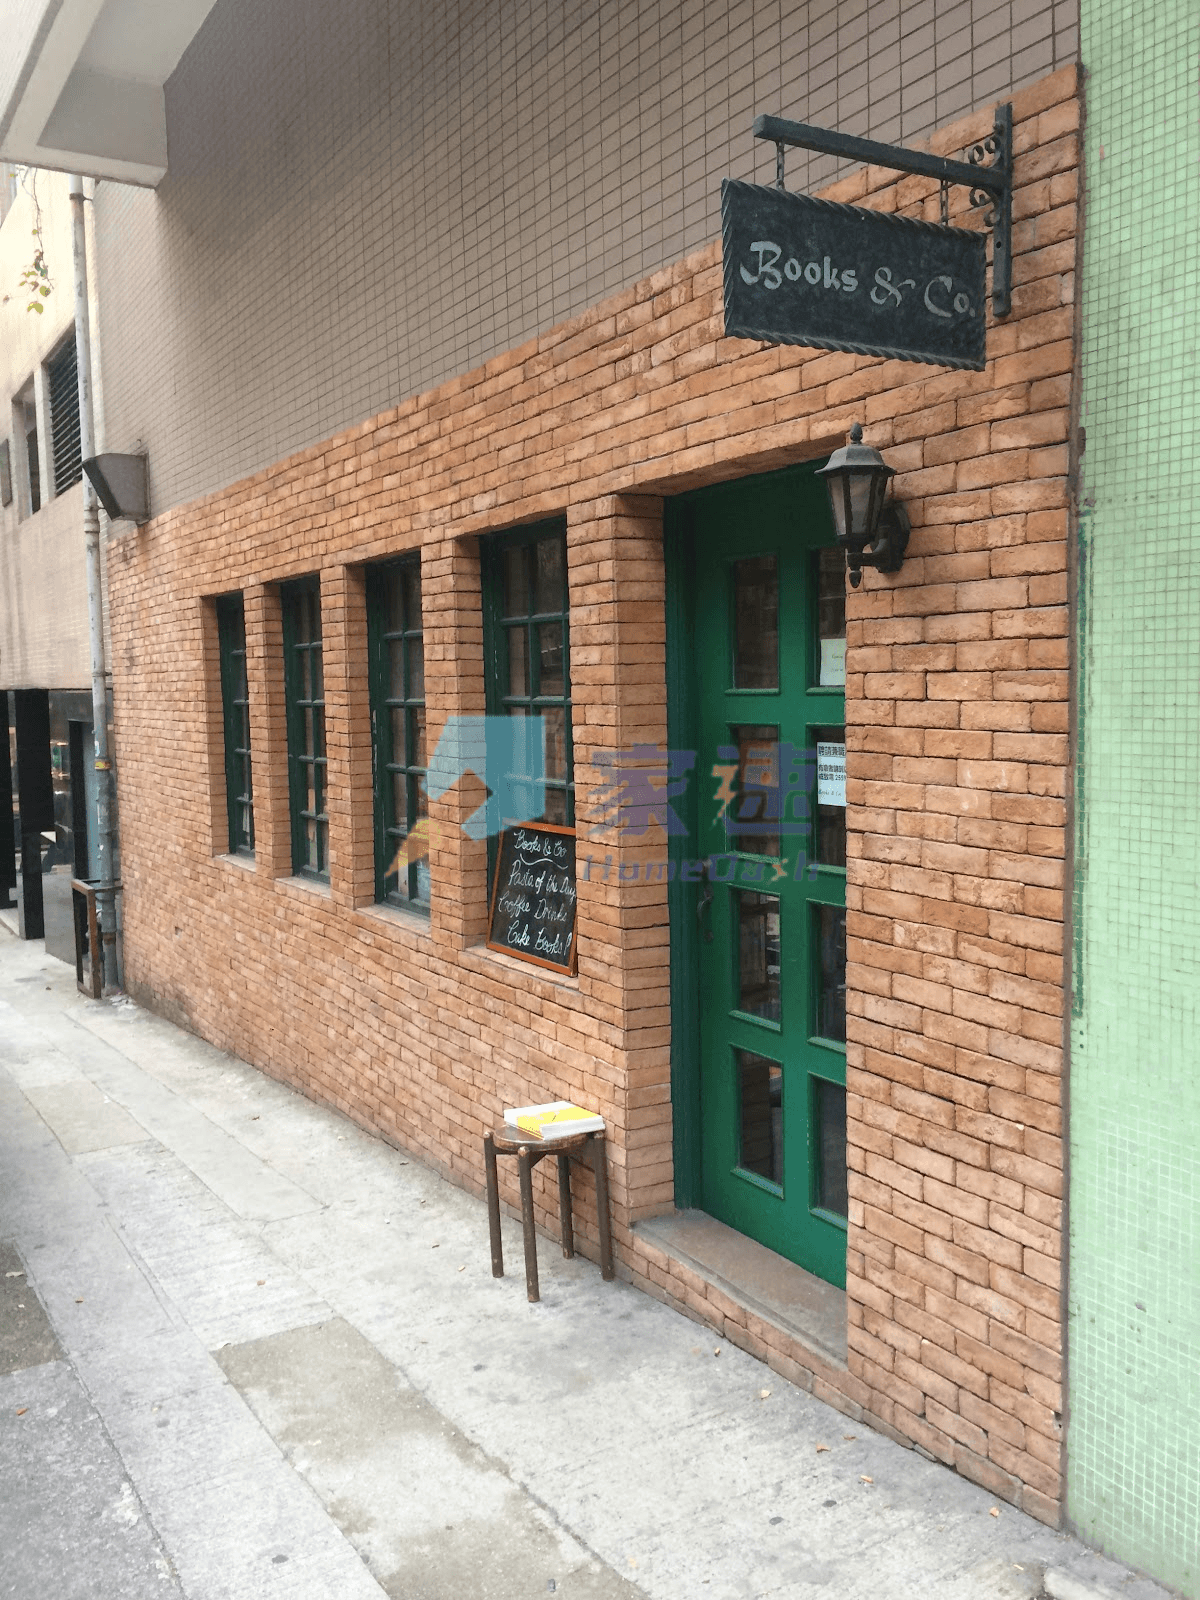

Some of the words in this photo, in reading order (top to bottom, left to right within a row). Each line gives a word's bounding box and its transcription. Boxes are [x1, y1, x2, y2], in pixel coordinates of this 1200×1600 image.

[739, 240, 859, 292] Books
[870, 267, 916, 308] &
[514, 830, 541, 853] Books
[543, 838, 552, 857] &
[508, 859, 534, 887] Pasta
[535, 870, 546, 895] of
[546, 874, 558, 893] the
[559, 876, 575, 905] Day
[498, 890, 530, 918] Coffee
[534, 898, 566, 922] Drinks
[507, 920, 530, 947] Cake
